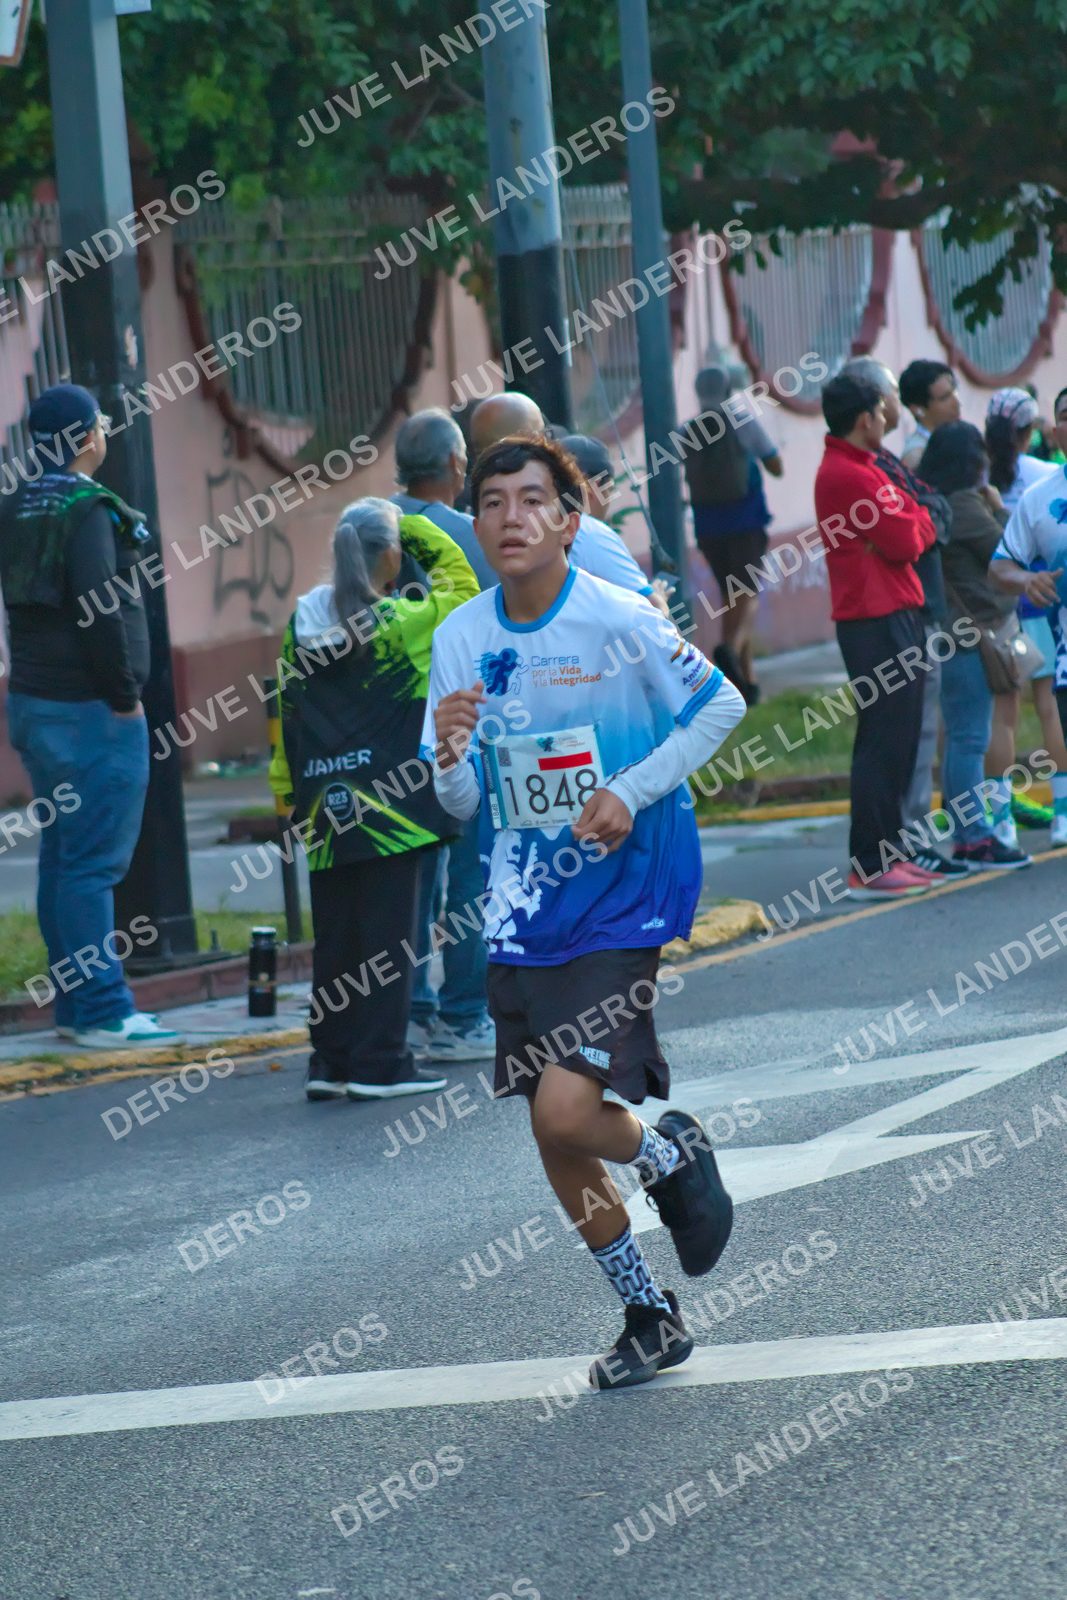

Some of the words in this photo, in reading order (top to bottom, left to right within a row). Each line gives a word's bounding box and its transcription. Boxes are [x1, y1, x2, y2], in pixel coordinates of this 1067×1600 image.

[531, 655, 580, 667] Carrera
[559, 666, 581, 675] Vida
[549, 672, 602, 687] Integridad
[504, 768, 598, 815] 1848
